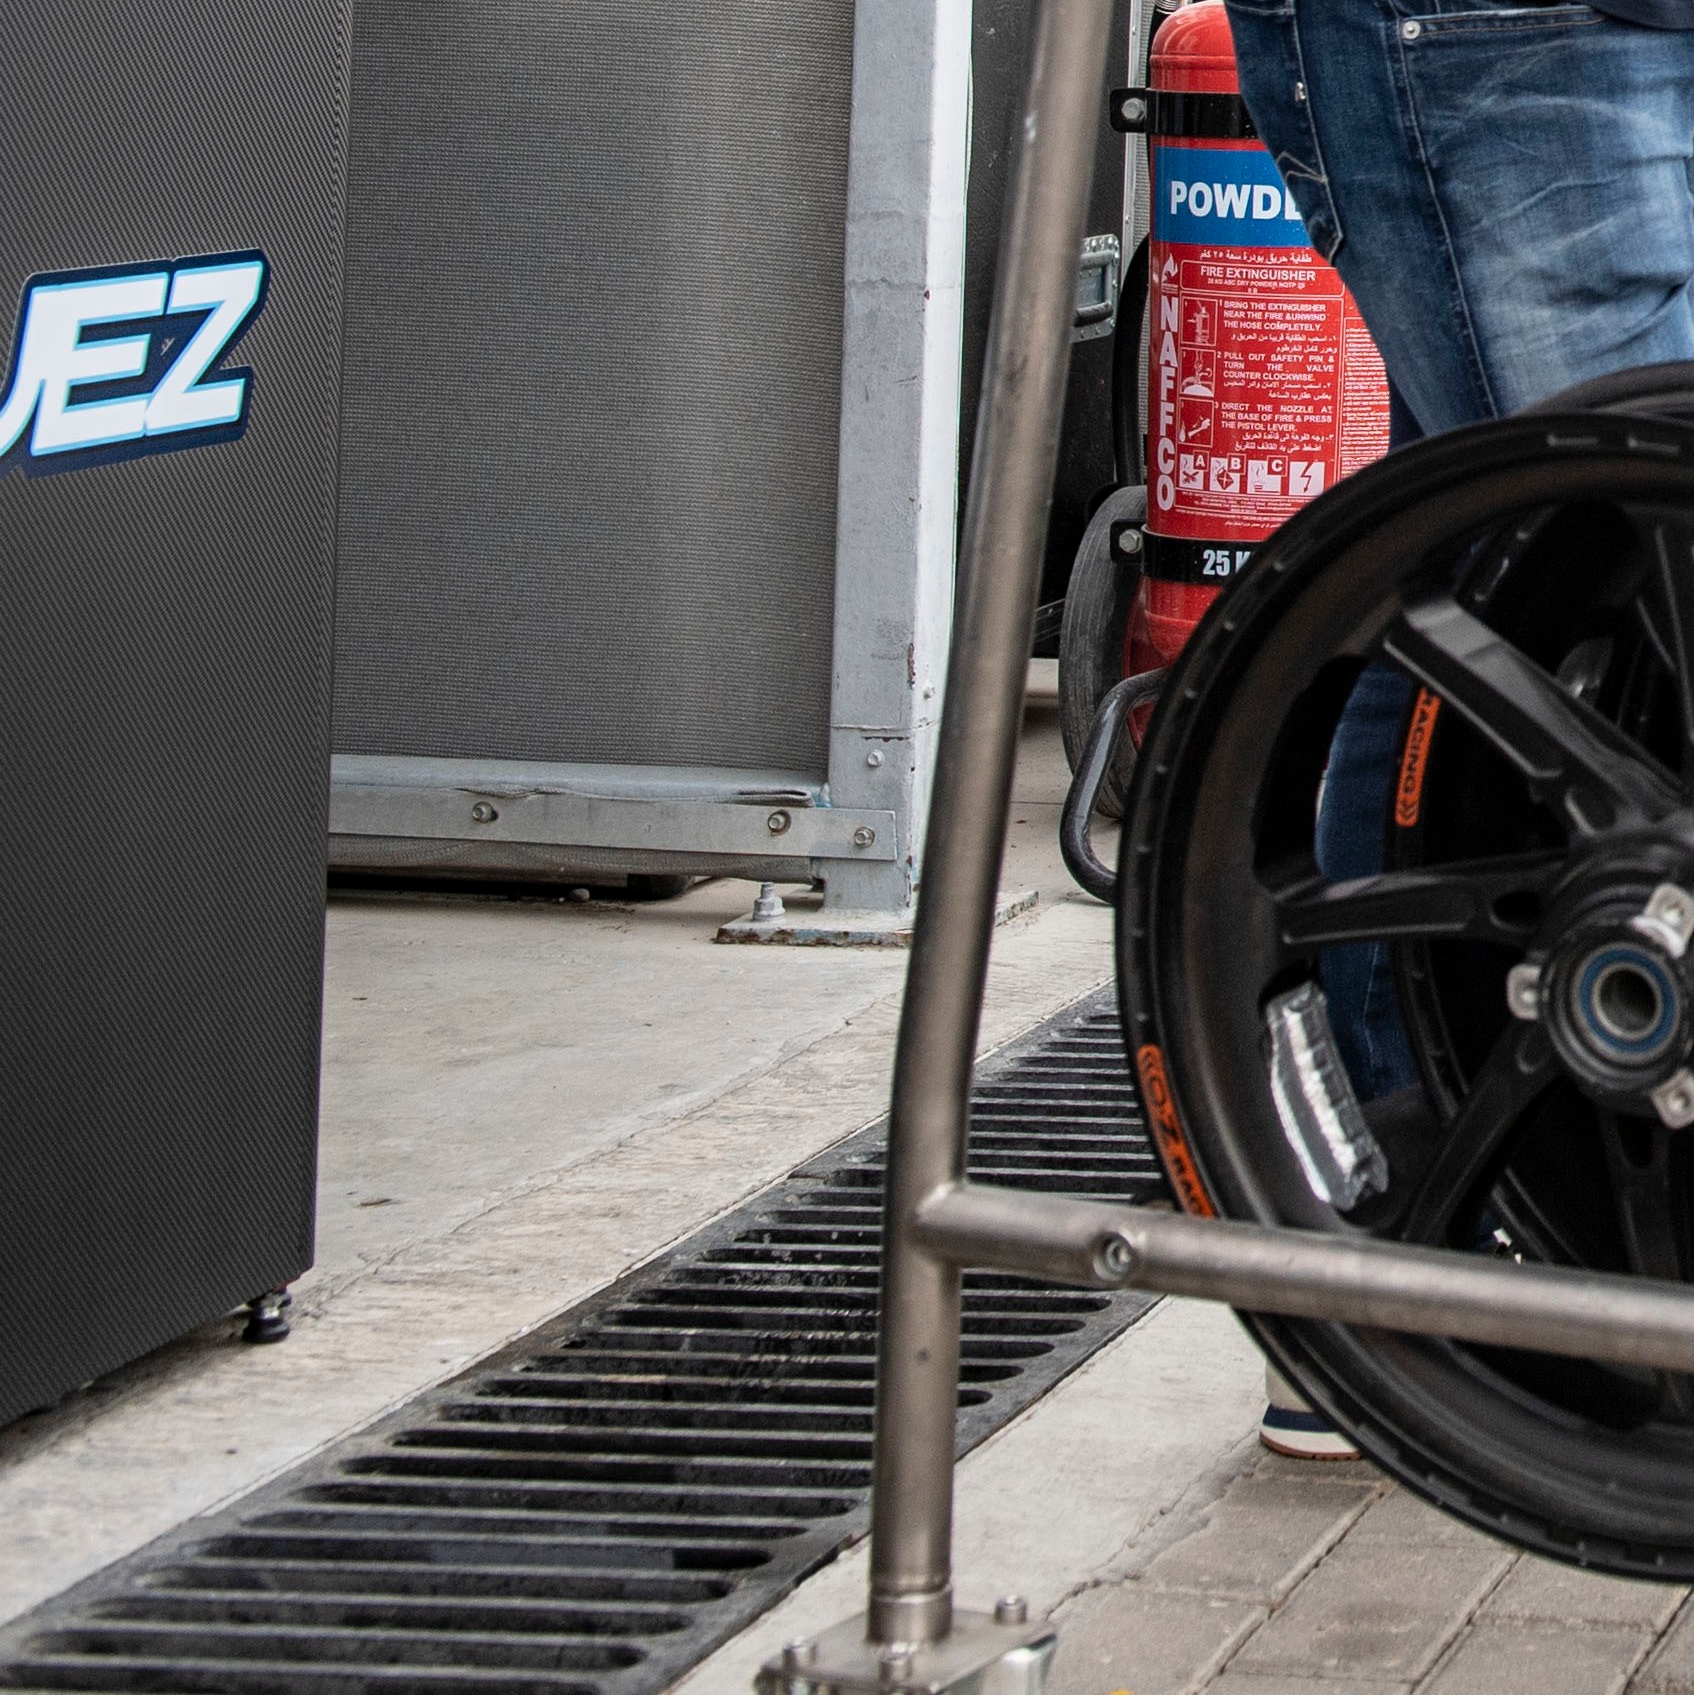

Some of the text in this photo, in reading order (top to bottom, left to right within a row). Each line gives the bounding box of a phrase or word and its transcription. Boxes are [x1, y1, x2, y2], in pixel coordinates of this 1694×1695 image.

[1200, 266, 1316, 281] FIRE EXTINGUISHER
[1224, 301, 1248, 309] BRING
[1250, 302, 1266, 310] THE
[1268, 303, 1326, 312] EXTINGUISHER
[1247, 311, 1262, 319] THE
[1265, 312, 1283, 320] FIRE
[1224, 320, 1239, 328] THE
[1240, 321, 1262, 329] HOSE
[1224, 351, 1243, 360] PULL
[1248, 353, 1265, 361] OUT
[1270, 354, 1303, 362] SAFETY
[1224, 361, 1334, 372] TURN THE VALVE
[1223, 370, 1261, 380] COUNTER
[1156, 295, 1178, 510] NAFFCO
[1221, 402, 1250, 411] DIRECT
[1257, 404, 1273, 412] THE
[1280, 405, 1314, 413] NOZZLE
[1221, 411, 1236, 419] THE
[1238, 413, 1260, 421] BASE
[1274, 414, 1294, 422] FIRE
[1296, 414, 1302, 422] &
[1304, 415, 1332, 423] PRESS
[1221, 421, 1236, 429] THE
[1237, 422, 1266, 430] PISTOL
[1195, 455, 1205, 467] A
[1230, 457, 1242, 470] B
[1271, 459, 1283, 472] C
[1203, 549, 1231, 576] 25
